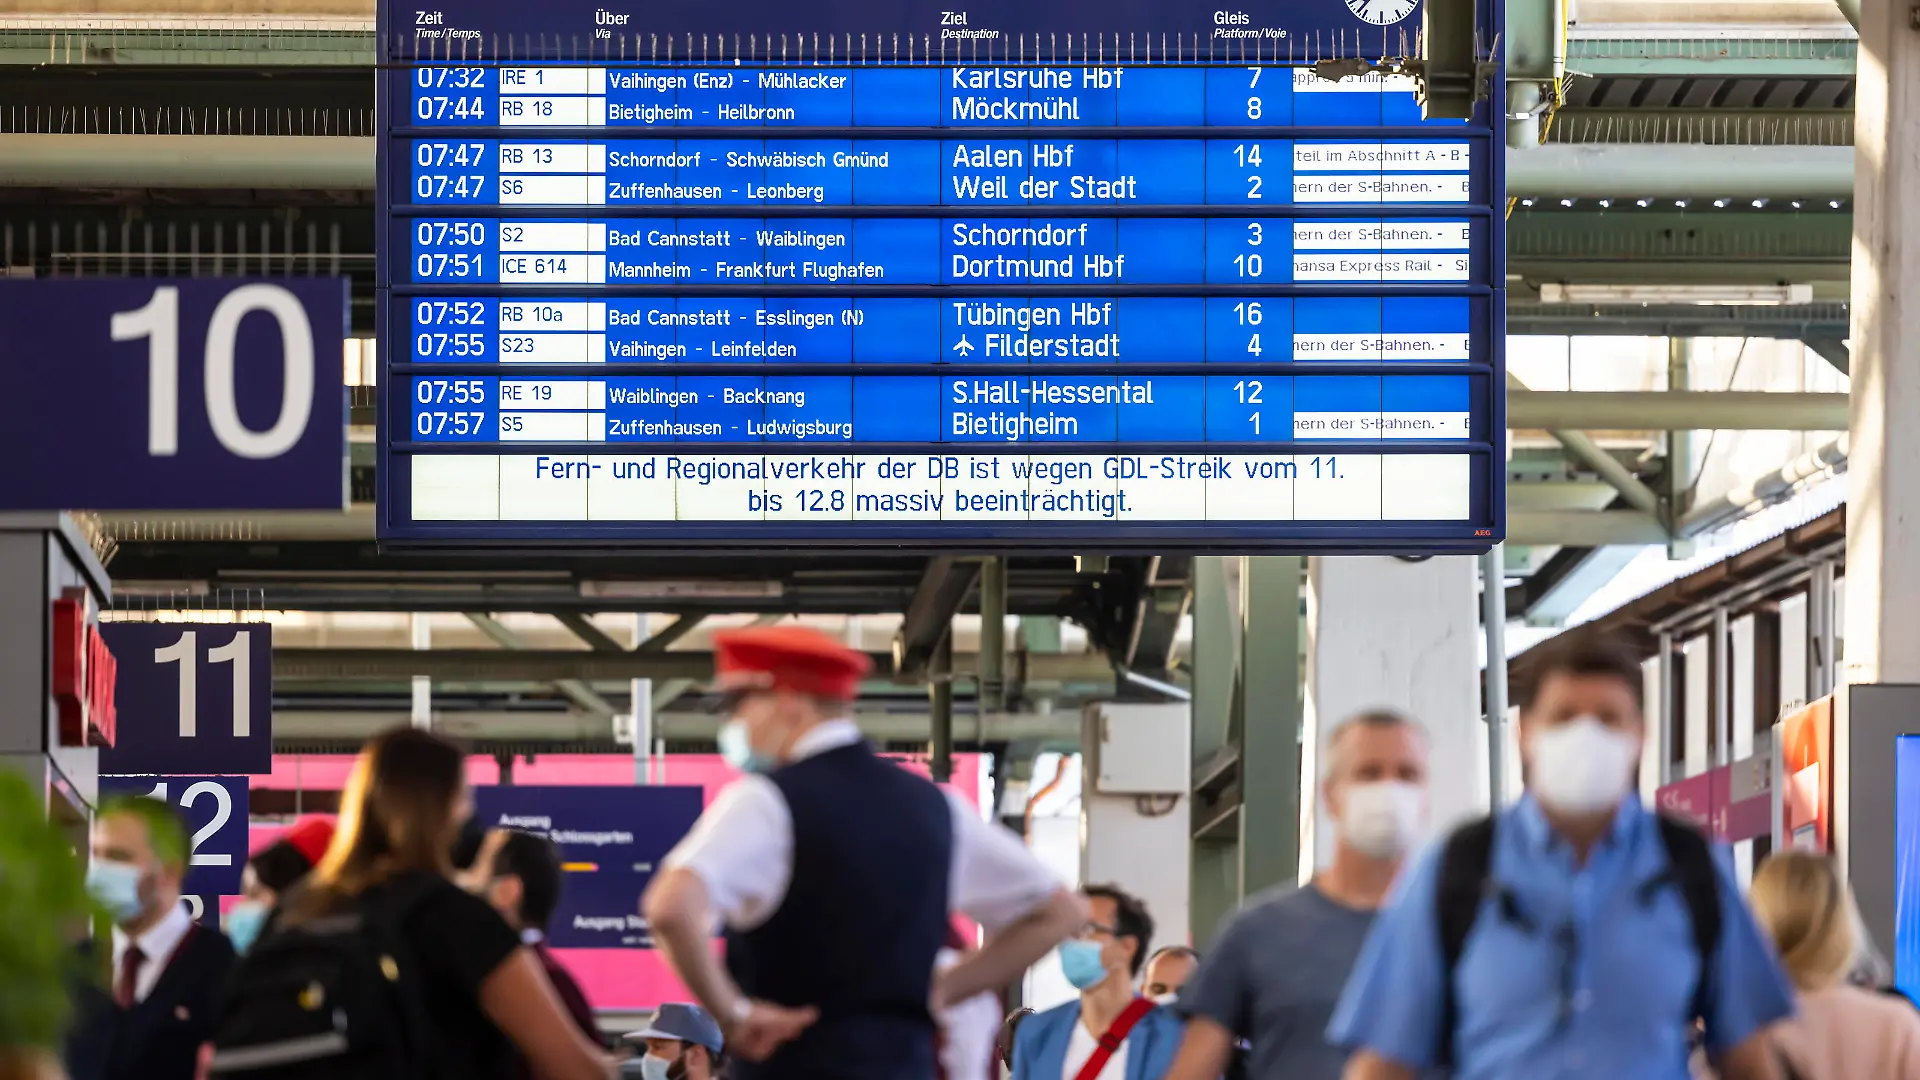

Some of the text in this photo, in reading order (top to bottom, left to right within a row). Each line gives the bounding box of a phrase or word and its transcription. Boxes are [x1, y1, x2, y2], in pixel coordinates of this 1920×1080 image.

[415, 11, 443, 25] Zeit
[595, 9, 630, 25] Über
[941, 11, 968, 25] Ziel
[1213, 11, 1250, 25] Gleis
[595, 28, 611, 38] Via
[941, 28, 1000, 39] Destination
[418, 67, 485, 88] 07:32
[502, 69, 543, 84] IRE 1
[610, 73, 686, 92] Vaihingen
[693, 73, 733, 90] (Enz)
[758, 72, 846, 89] Mühlacker
[952, 67, 1123, 88] Karlsruhe Hbf
[1247, 67, 1261, 88] 7
[418, 97, 485, 119] 07:44
[502, 101, 552, 116] RB 18
[609, 104, 692, 123] Bietigheim
[718, 104, 794, 119] Heilbronn
[952, 97, 1079, 119] Möckmühl
[1247, 97, 1262, 119] 8
[418, 144, 485, 166] 07:47
[502, 149, 552, 163] RB 13
[609, 152, 701, 167] Schorndorf
[727, 152, 826, 168] Schwäbisch
[833, 152, 888, 168] Gmünd
[952, 145, 1073, 167] Aalen Hbf
[1233, 145, 1262, 167] 14
[1296, 150, 1321, 161] teil
[1326, 150, 1342, 161] im
[1347, 150, 1420, 161] Abschnitt
[1425, 150, 1436, 161] A
[1451, 150, 1460, 161] B
[418, 176, 485, 198] 07:47
[502, 179, 523, 195] S6
[609, 183, 722, 198] Zuffenhausen
[748, 183, 823, 202] Leonberg
[953, 176, 1136, 198] Weil der Stadt
[1247, 176, 1262, 198] 2
[1328, 181, 1353, 193] der
[1358, 181, 1432, 193] S-Bahnen.
[418, 223, 485, 245] 07:50
[502, 227, 523, 242] S2
[610, 230, 641, 246] Bad
[647, 230, 730, 246] Cannstatt
[756, 231, 845, 250] Waiblingen
[953, 223, 1087, 246] Schorndorf
[1247, 223, 1262, 246] 3
[1328, 229, 1353, 240] der
[1358, 229, 1432, 241] S-Bahnen.
[418, 254, 482, 277] 07:51
[502, 258, 566, 273] ICE 614
[609, 262, 691, 277] Mannheim
[716, 262, 796, 277] Frankfurt
[803, 262, 884, 281] Flughafen
[952, 255, 1124, 277] Dortmund Hbf
[1233, 254, 1262, 277] 10
[1340, 260, 1400, 274] Express
[1405, 260, 1432, 271] Rail
[418, 302, 485, 324] 07:52
[502, 306, 563, 321] RB 10a
[610, 310, 641, 325] Bad
[647, 310, 730, 325] Cannstatt
[755, 310, 834, 329] Esslingen
[841, 310, 864, 327] (N)
[953, 303, 1111, 330] Tübingen Hbf
[1233, 303, 1262, 325] 16
[418, 333, 485, 356] 07:55
[502, 337, 534, 353] S23
[609, 341, 687, 360] Vaihingen
[711, 341, 797, 356] Leinfelden
[985, 334, 1120, 356] Filderstadt
[1247, 334, 1262, 356] 4
[1331, 339, 1355, 351] der
[1360, 339, 1434, 351] S-Bahnen.
[110, 283, 315, 460] 10
[418, 381, 485, 403] 07:55
[502, 385, 552, 400] RE 19
[609, 388, 698, 407] Waiblingen
[723, 388, 805, 407] Backnang
[953, 381, 1154, 404] S.Hall-Hessental
[1233, 381, 1262, 404] 12
[418, 412, 485, 435] 07:57
[502, 416, 523, 431] S5
[609, 420, 722, 435] Zuffenhausen
[747, 420, 853, 439] Ludwigsburg
[953, 412, 1078, 439] Bietigheim
[1248, 412, 1260, 434] 1
[1331, 418, 1355, 430] der
[1360, 418, 1434, 430] S-Bahnen.
[536, 457, 1344, 485] Fern- und Regionalverkehr der DB ist wegen GDL-Streik vom 11.
[748, 489, 1132, 518] bis 12.8 massiv beeinträchtigt.
[154, 631, 250, 737] 11
[135, 781, 232, 866] 2
